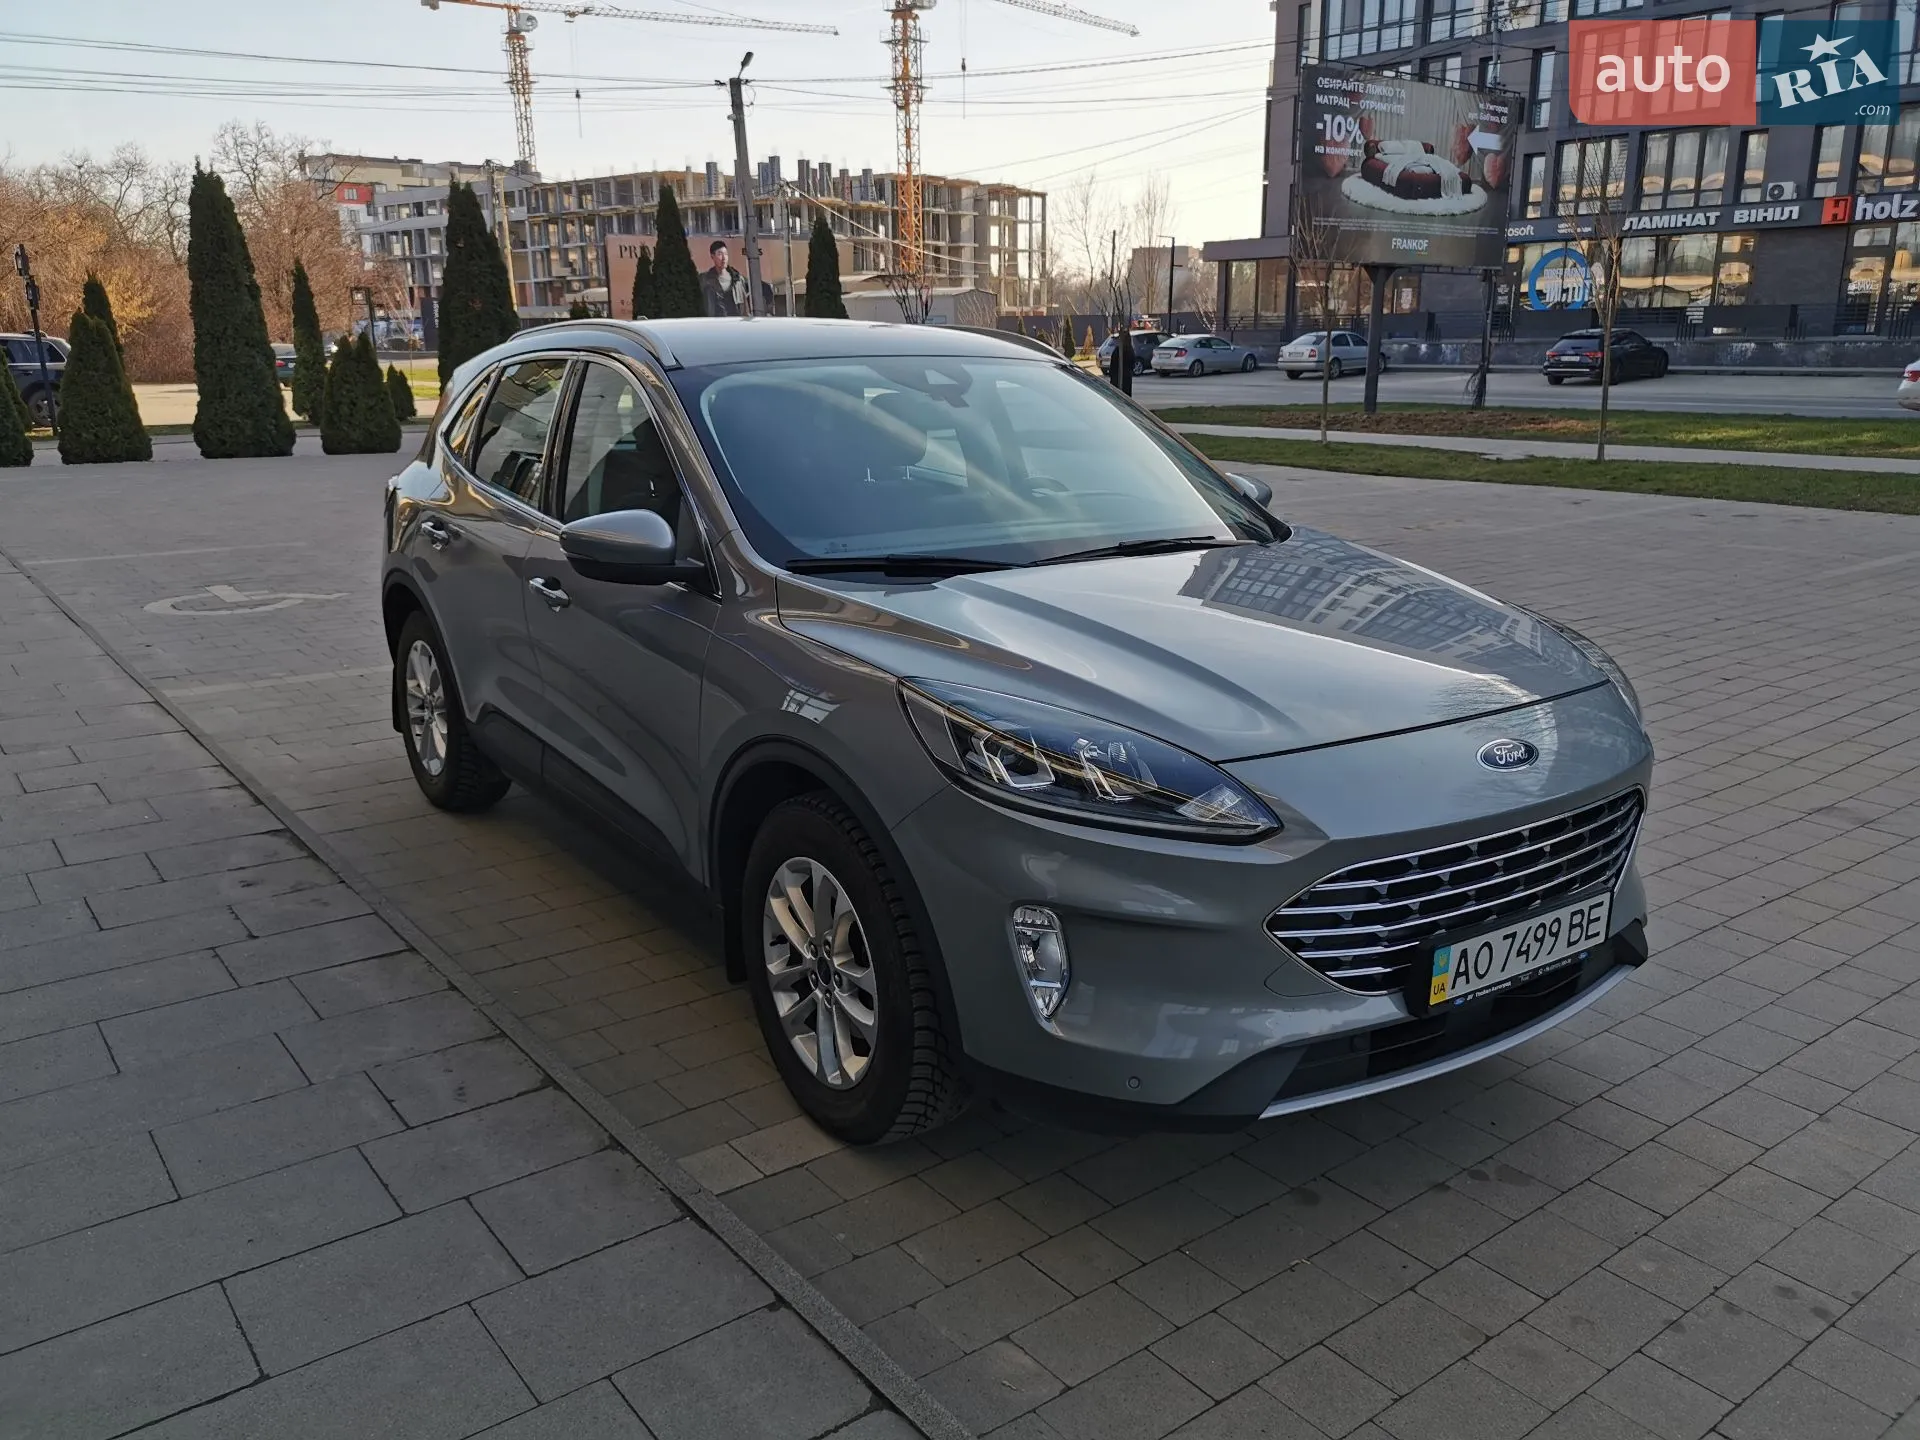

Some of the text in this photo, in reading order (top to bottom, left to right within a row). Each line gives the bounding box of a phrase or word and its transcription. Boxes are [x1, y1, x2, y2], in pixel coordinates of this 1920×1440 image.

[1316, 94, 1350, 109] МАТРАЦ
[1360, 100, 1405, 114] ОТРИМУЙТЕ
[1395, 88, 1406, 99] ТА
[1316, 113, 1364, 145] -10%
[1314, 145, 1363, 157] на комплект
[1621, 205, 1801, 231] ЛАМІНАТ ВІНІЛ
[1855, 193, 1919, 222] holz
[1391, 237, 1429, 251] FRANKOF
[1494, 743, 1529, 765] Ford
[1451, 900, 1604, 990] AO 7499 BE
[1433, 984, 1446, 996] UA
